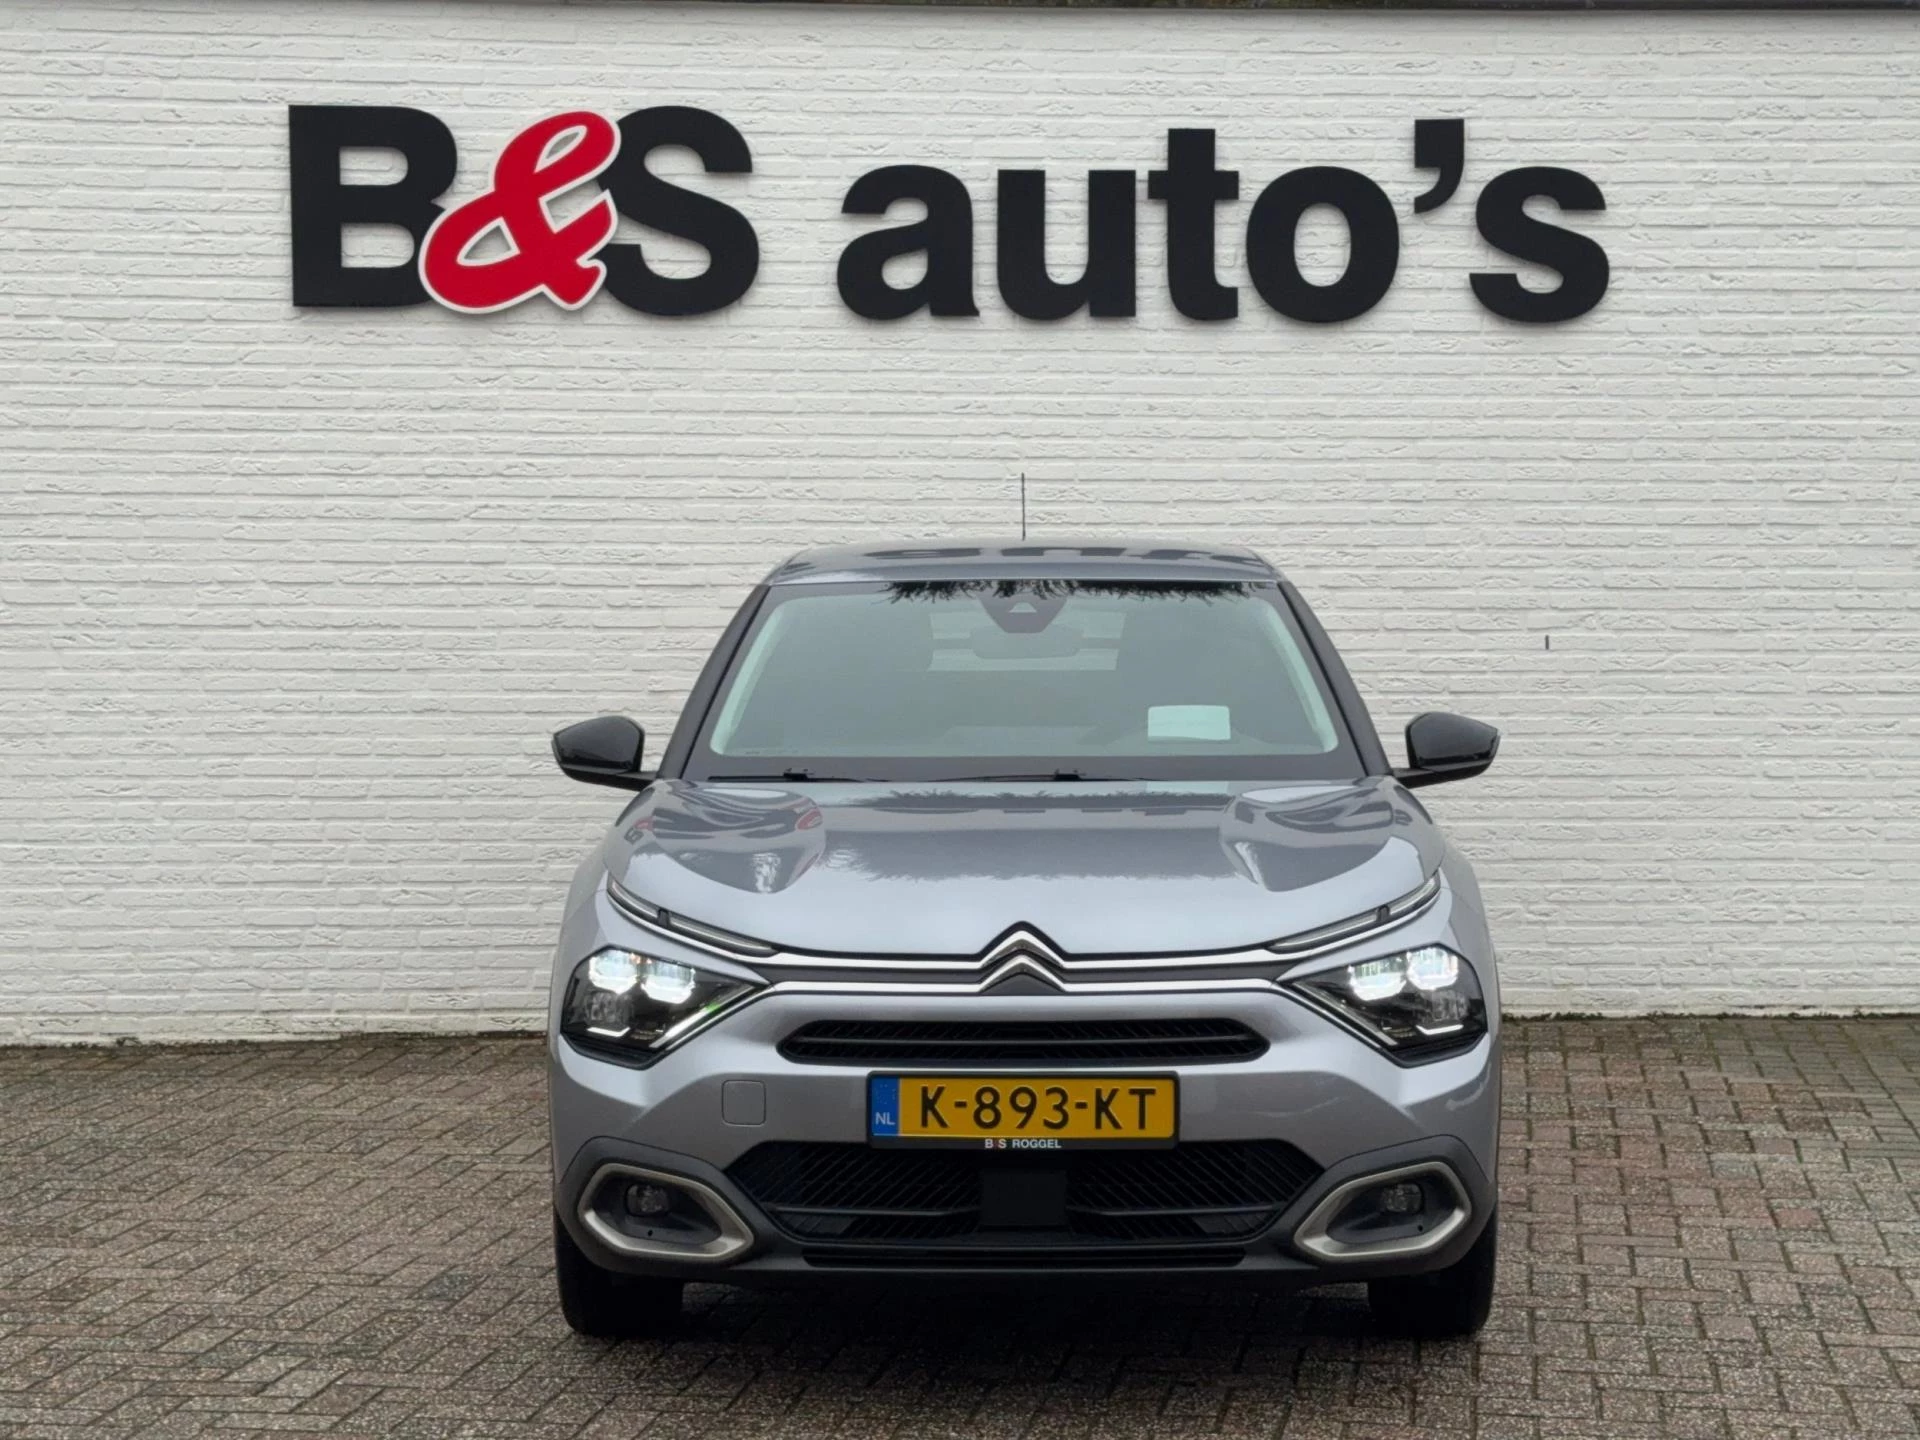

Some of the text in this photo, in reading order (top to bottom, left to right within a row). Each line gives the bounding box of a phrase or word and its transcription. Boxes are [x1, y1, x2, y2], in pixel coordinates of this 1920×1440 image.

[288, 104, 1611, 323] B&S auto's
[875, 1111, 895, 1126] NL
[919, 1085, 1156, 1130] K-893-KT
[1012, 1138, 1062, 1149] ROGGEL
